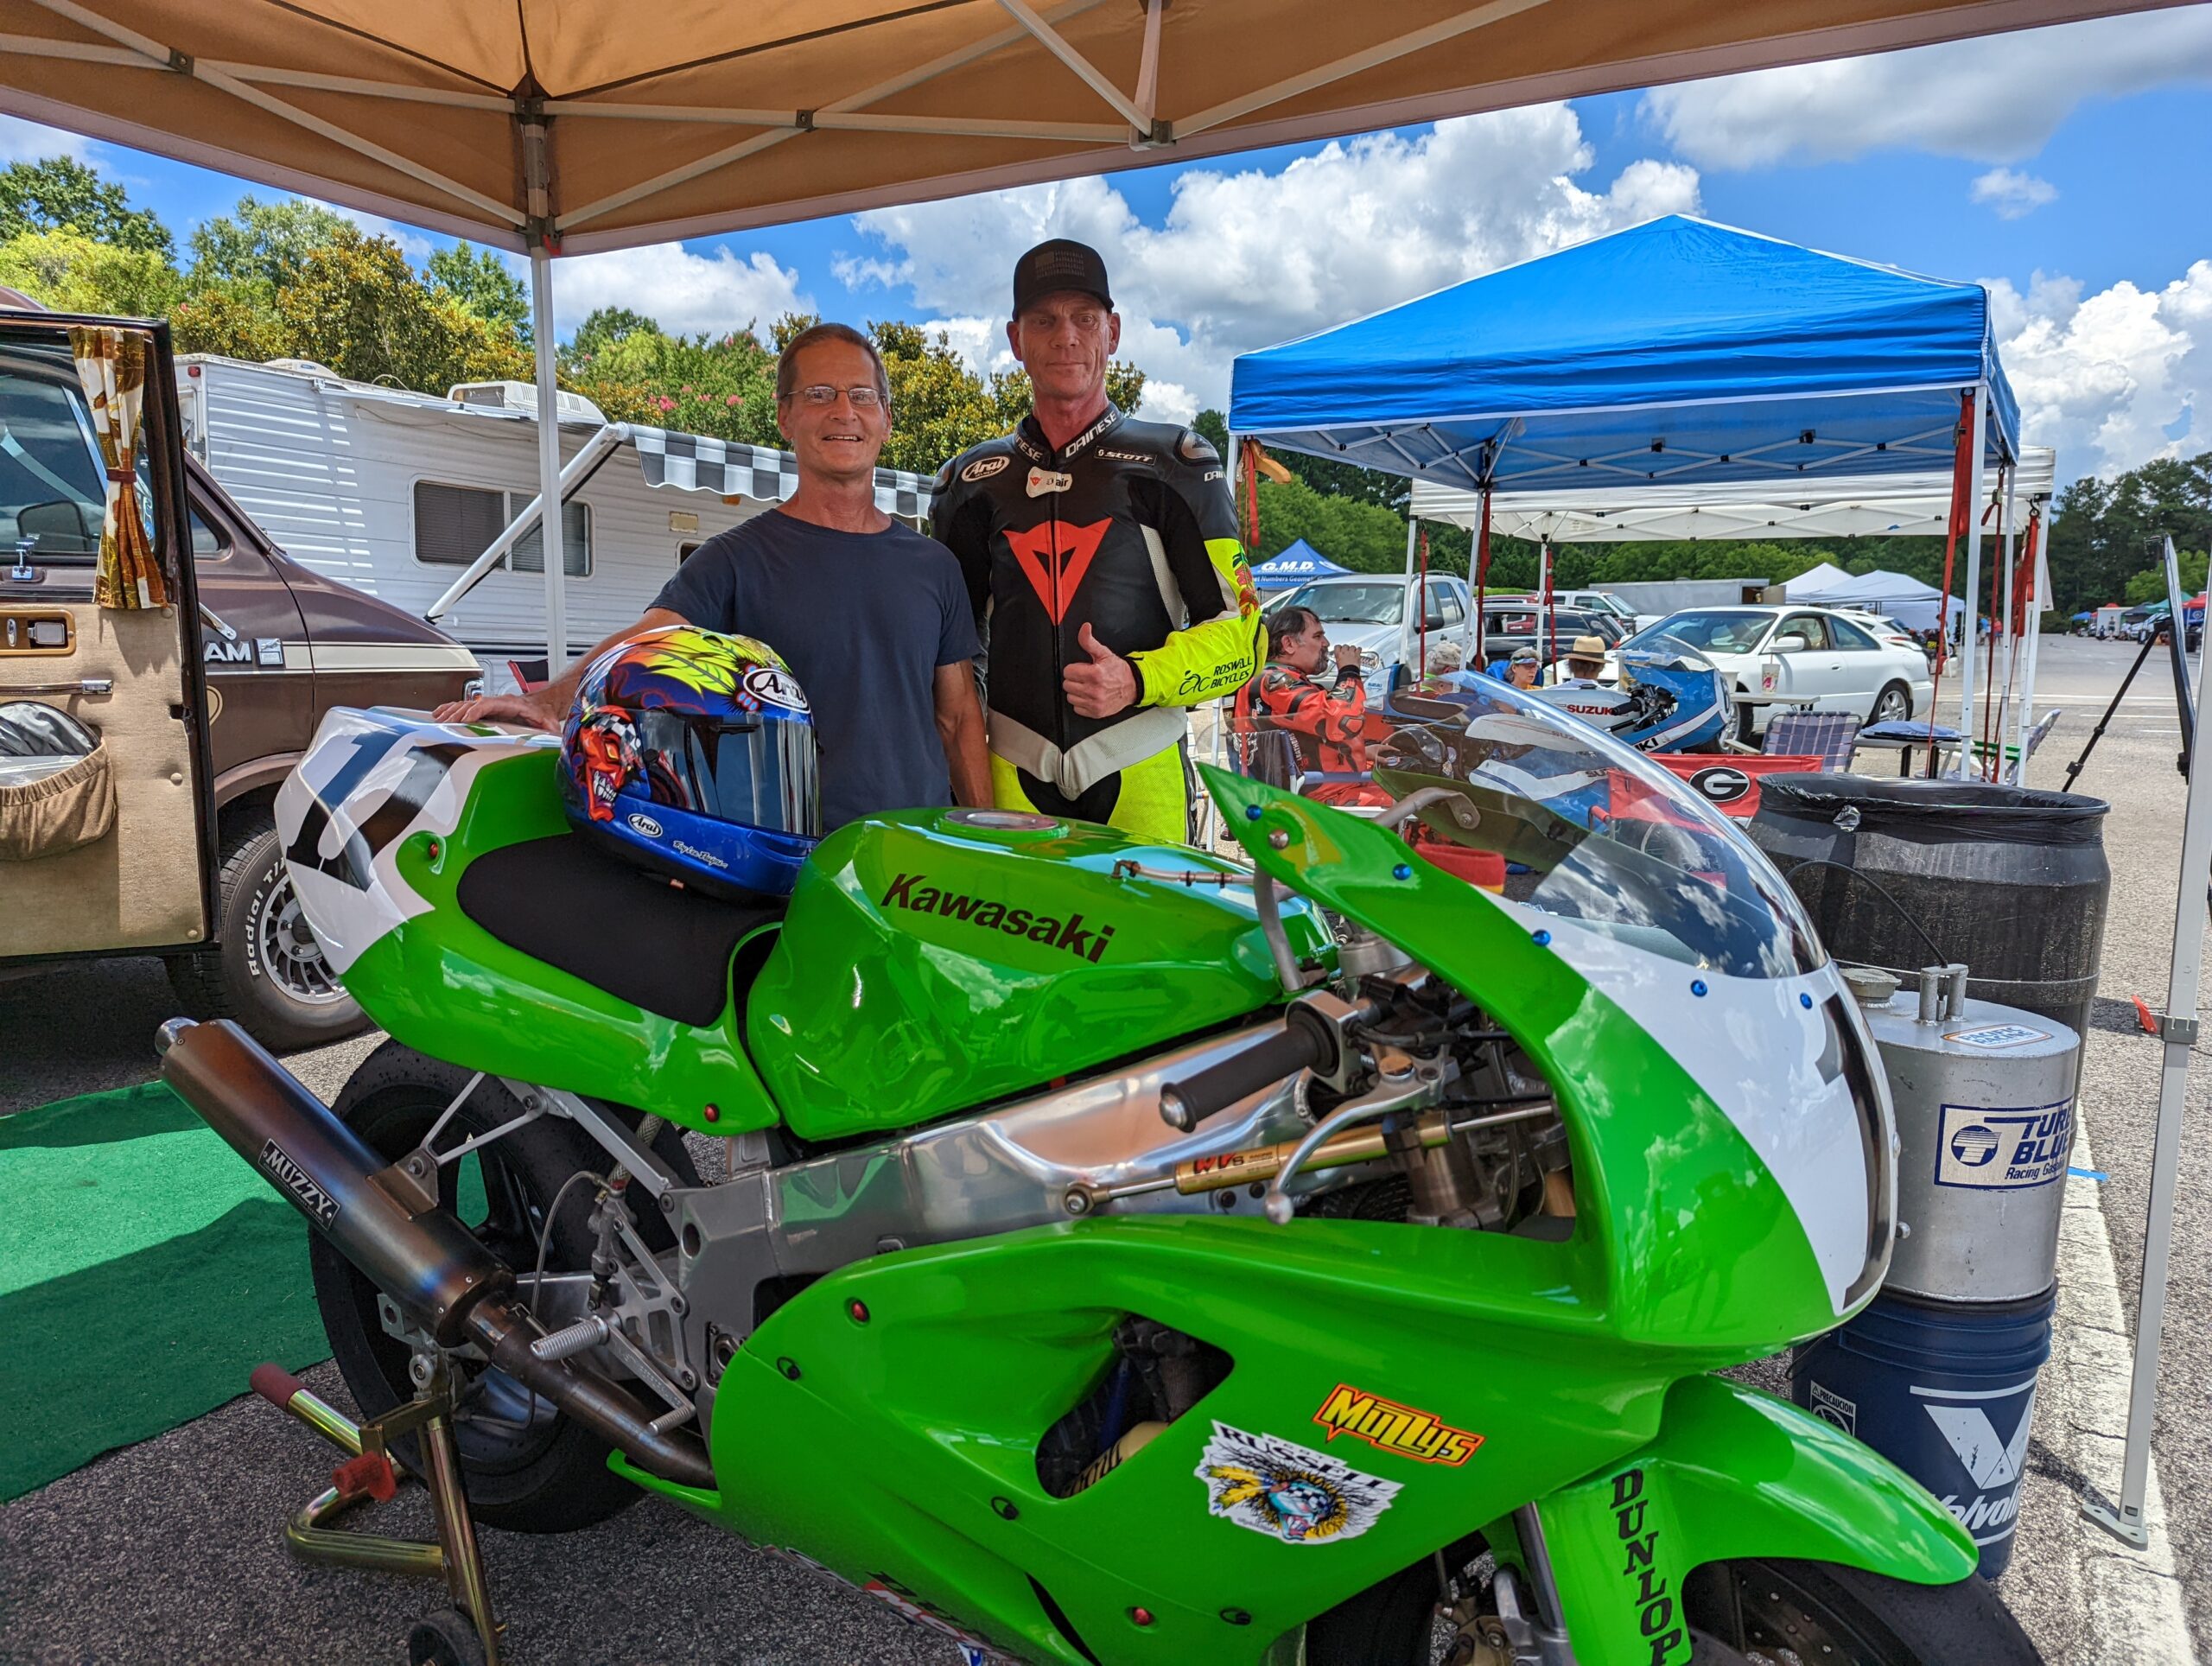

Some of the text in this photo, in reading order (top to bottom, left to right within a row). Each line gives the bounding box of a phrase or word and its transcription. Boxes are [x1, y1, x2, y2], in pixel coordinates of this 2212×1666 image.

[1065, 411, 1117, 458] DAINESE
[969, 458, 1003, 474] Arai
[1105, 451, 1153, 462] SCOTT
[1210, 669, 1249, 689] BICYCLES
[1567, 704, 1617, 715] SUZUK
[880, 873, 1116, 963] Kawasaki
[245, 889, 264, 976] Radial
[1957, 1027, 2023, 1040] PACIFIC
[2011, 1135, 2069, 1165] BLUE
[265, 1148, 332, 1215] MUZZY
[2005, 1167, 2040, 1180] Racing
[1820, 1389, 1854, 1415] PRECAUCION
[1219, 1425, 1383, 1489] RUSSELL
[1609, 1468, 1682, 1666] DUNLOP
